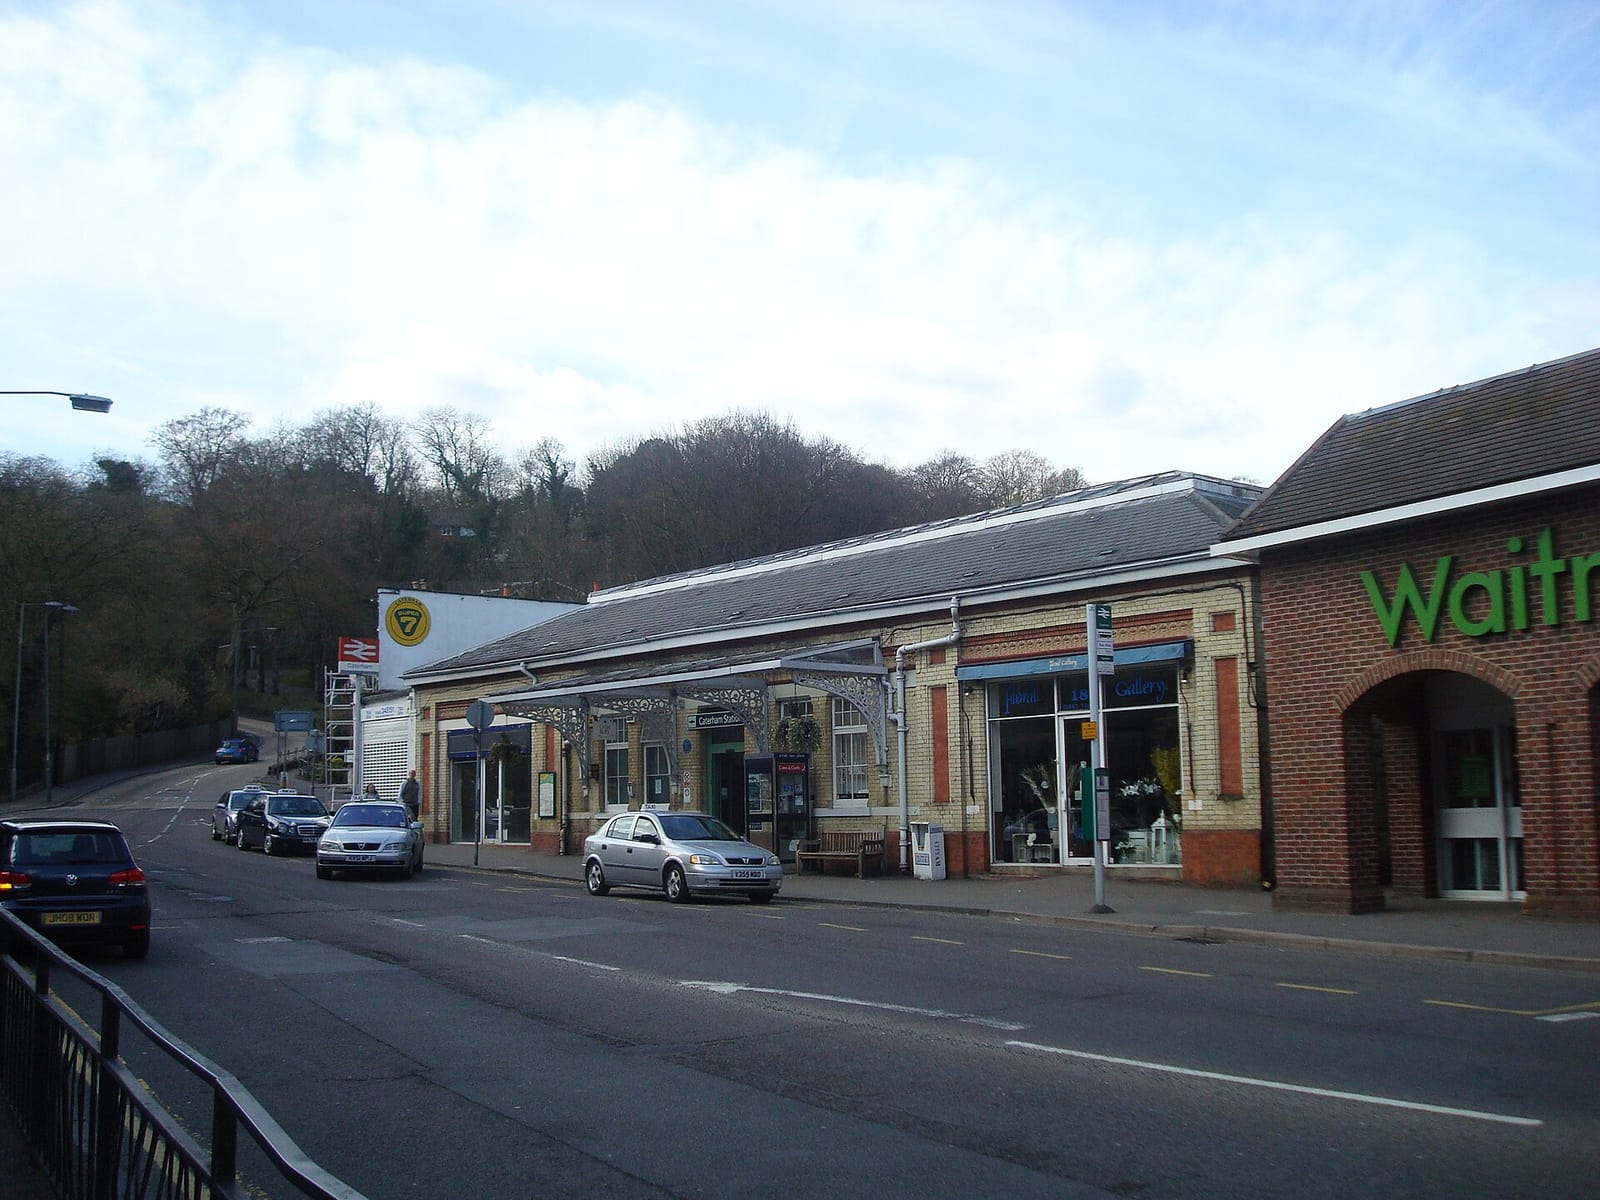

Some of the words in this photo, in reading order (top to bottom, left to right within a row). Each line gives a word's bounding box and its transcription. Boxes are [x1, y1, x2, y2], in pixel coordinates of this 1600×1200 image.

[1360, 527, 1600, 648] Waitr
[400, 616, 417, 633] 7
[699, 715, 723, 726] Caterham
